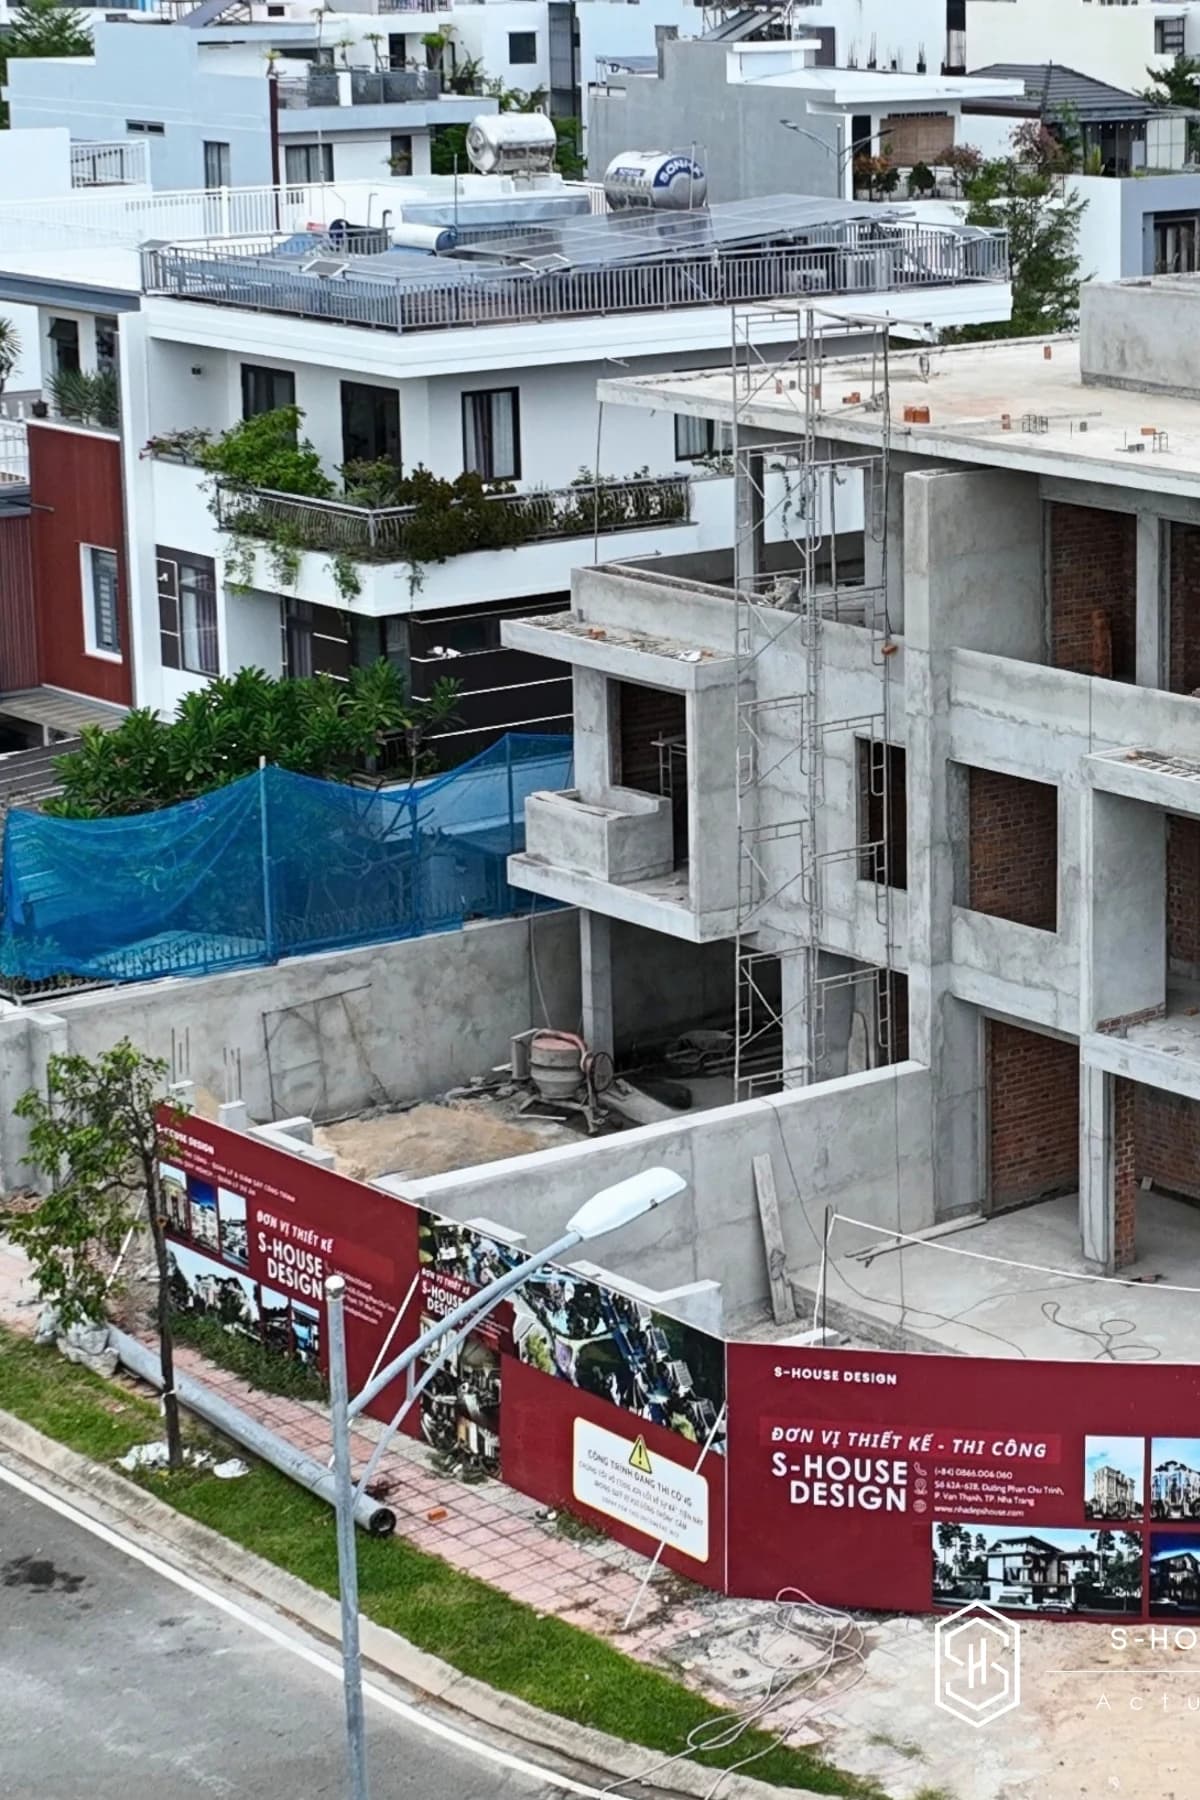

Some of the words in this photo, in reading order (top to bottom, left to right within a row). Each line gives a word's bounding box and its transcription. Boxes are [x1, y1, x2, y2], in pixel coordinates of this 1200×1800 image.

[280, 1220, 290, 1237] VỊ
[258, 1231, 323, 1279] S-HOUSE
[267, 1257, 323, 1301] DESIGN
[427, 1297, 455, 1317] DESI
[773, 1366, 840, 1381] S-HOUSE
[843, 1371, 897, 1385] DESIGN
[771, 1426, 814, 1443] ĐƠN
[821, 1429, 841, 1448] VỊ
[848, 1430, 903, 1449] THIẾT
[908, 1433, 934, 1451] KẾ
[952, 1439, 986, 1455] THI
[991, 1438, 1047, 1458] CÔNG
[771, 1452, 908, 1485] S-HOUSE
[790, 1479, 907, 1513] DESIGN
